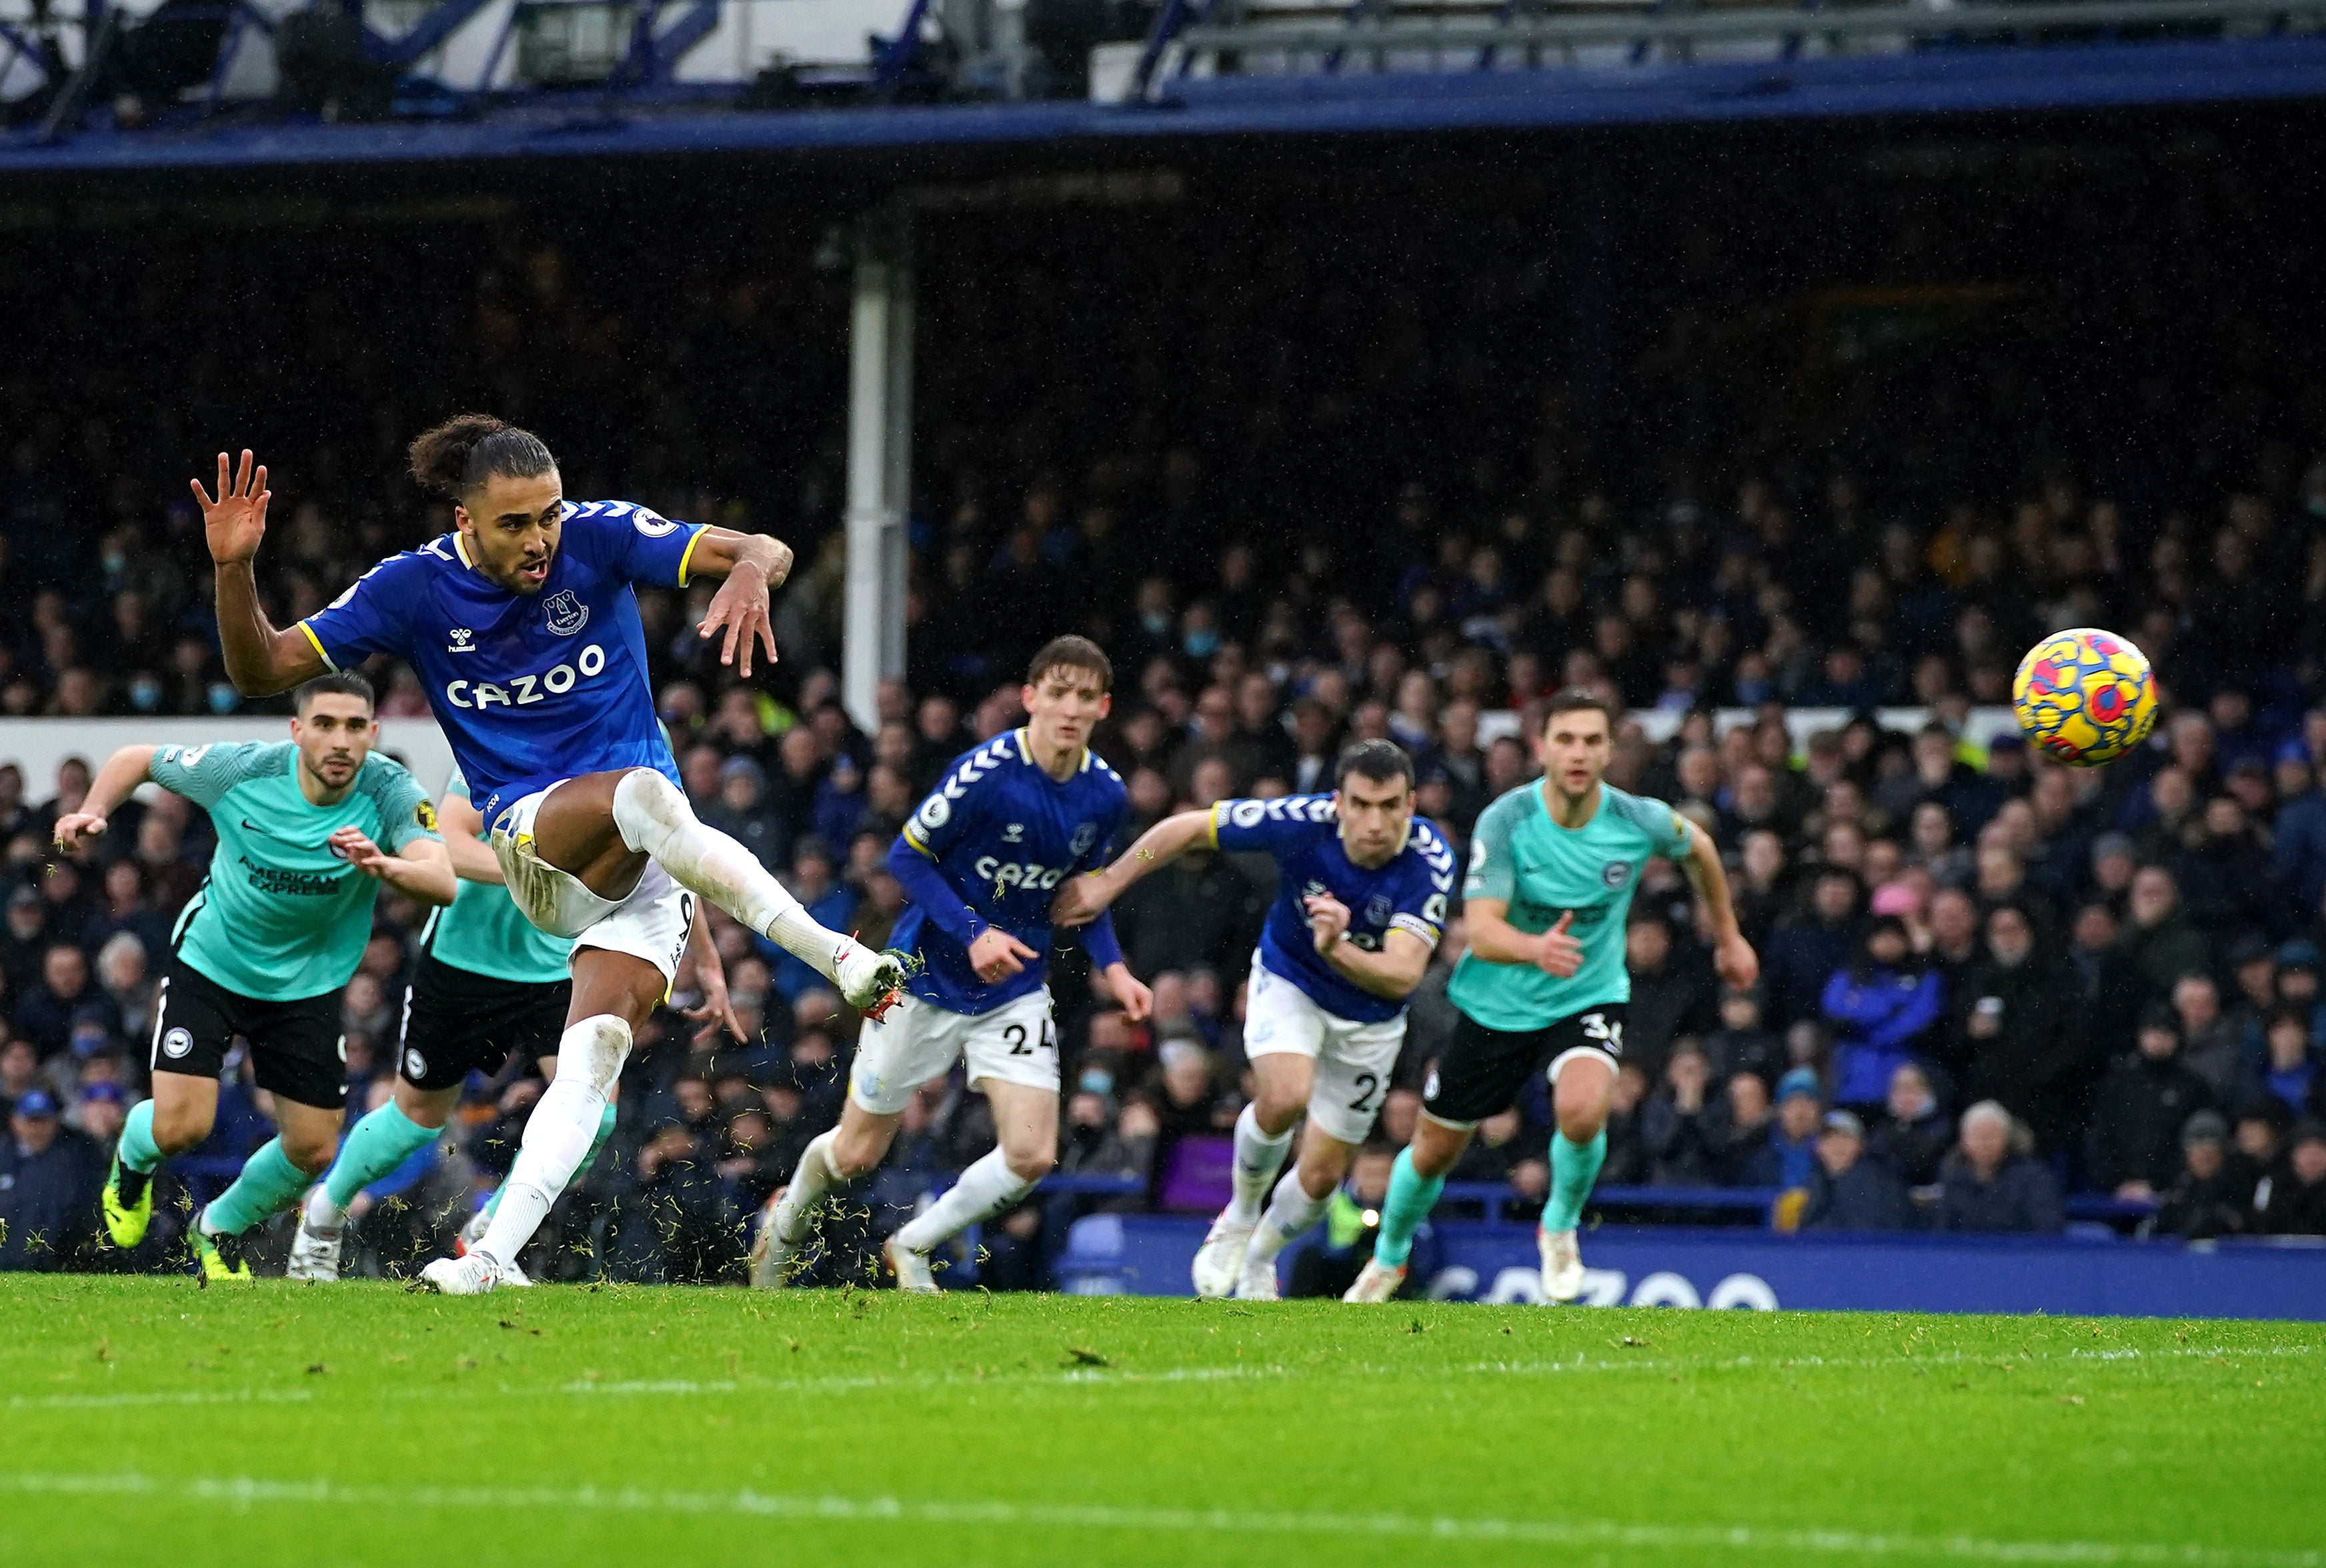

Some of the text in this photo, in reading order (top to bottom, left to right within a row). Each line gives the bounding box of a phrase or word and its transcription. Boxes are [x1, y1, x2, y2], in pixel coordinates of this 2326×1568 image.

[447, 644, 605, 709] CAZOO
[975, 855, 1071, 890] CAZO
[679, 893, 692, 942] 9
[1348, 1073, 1391, 1112] 2
